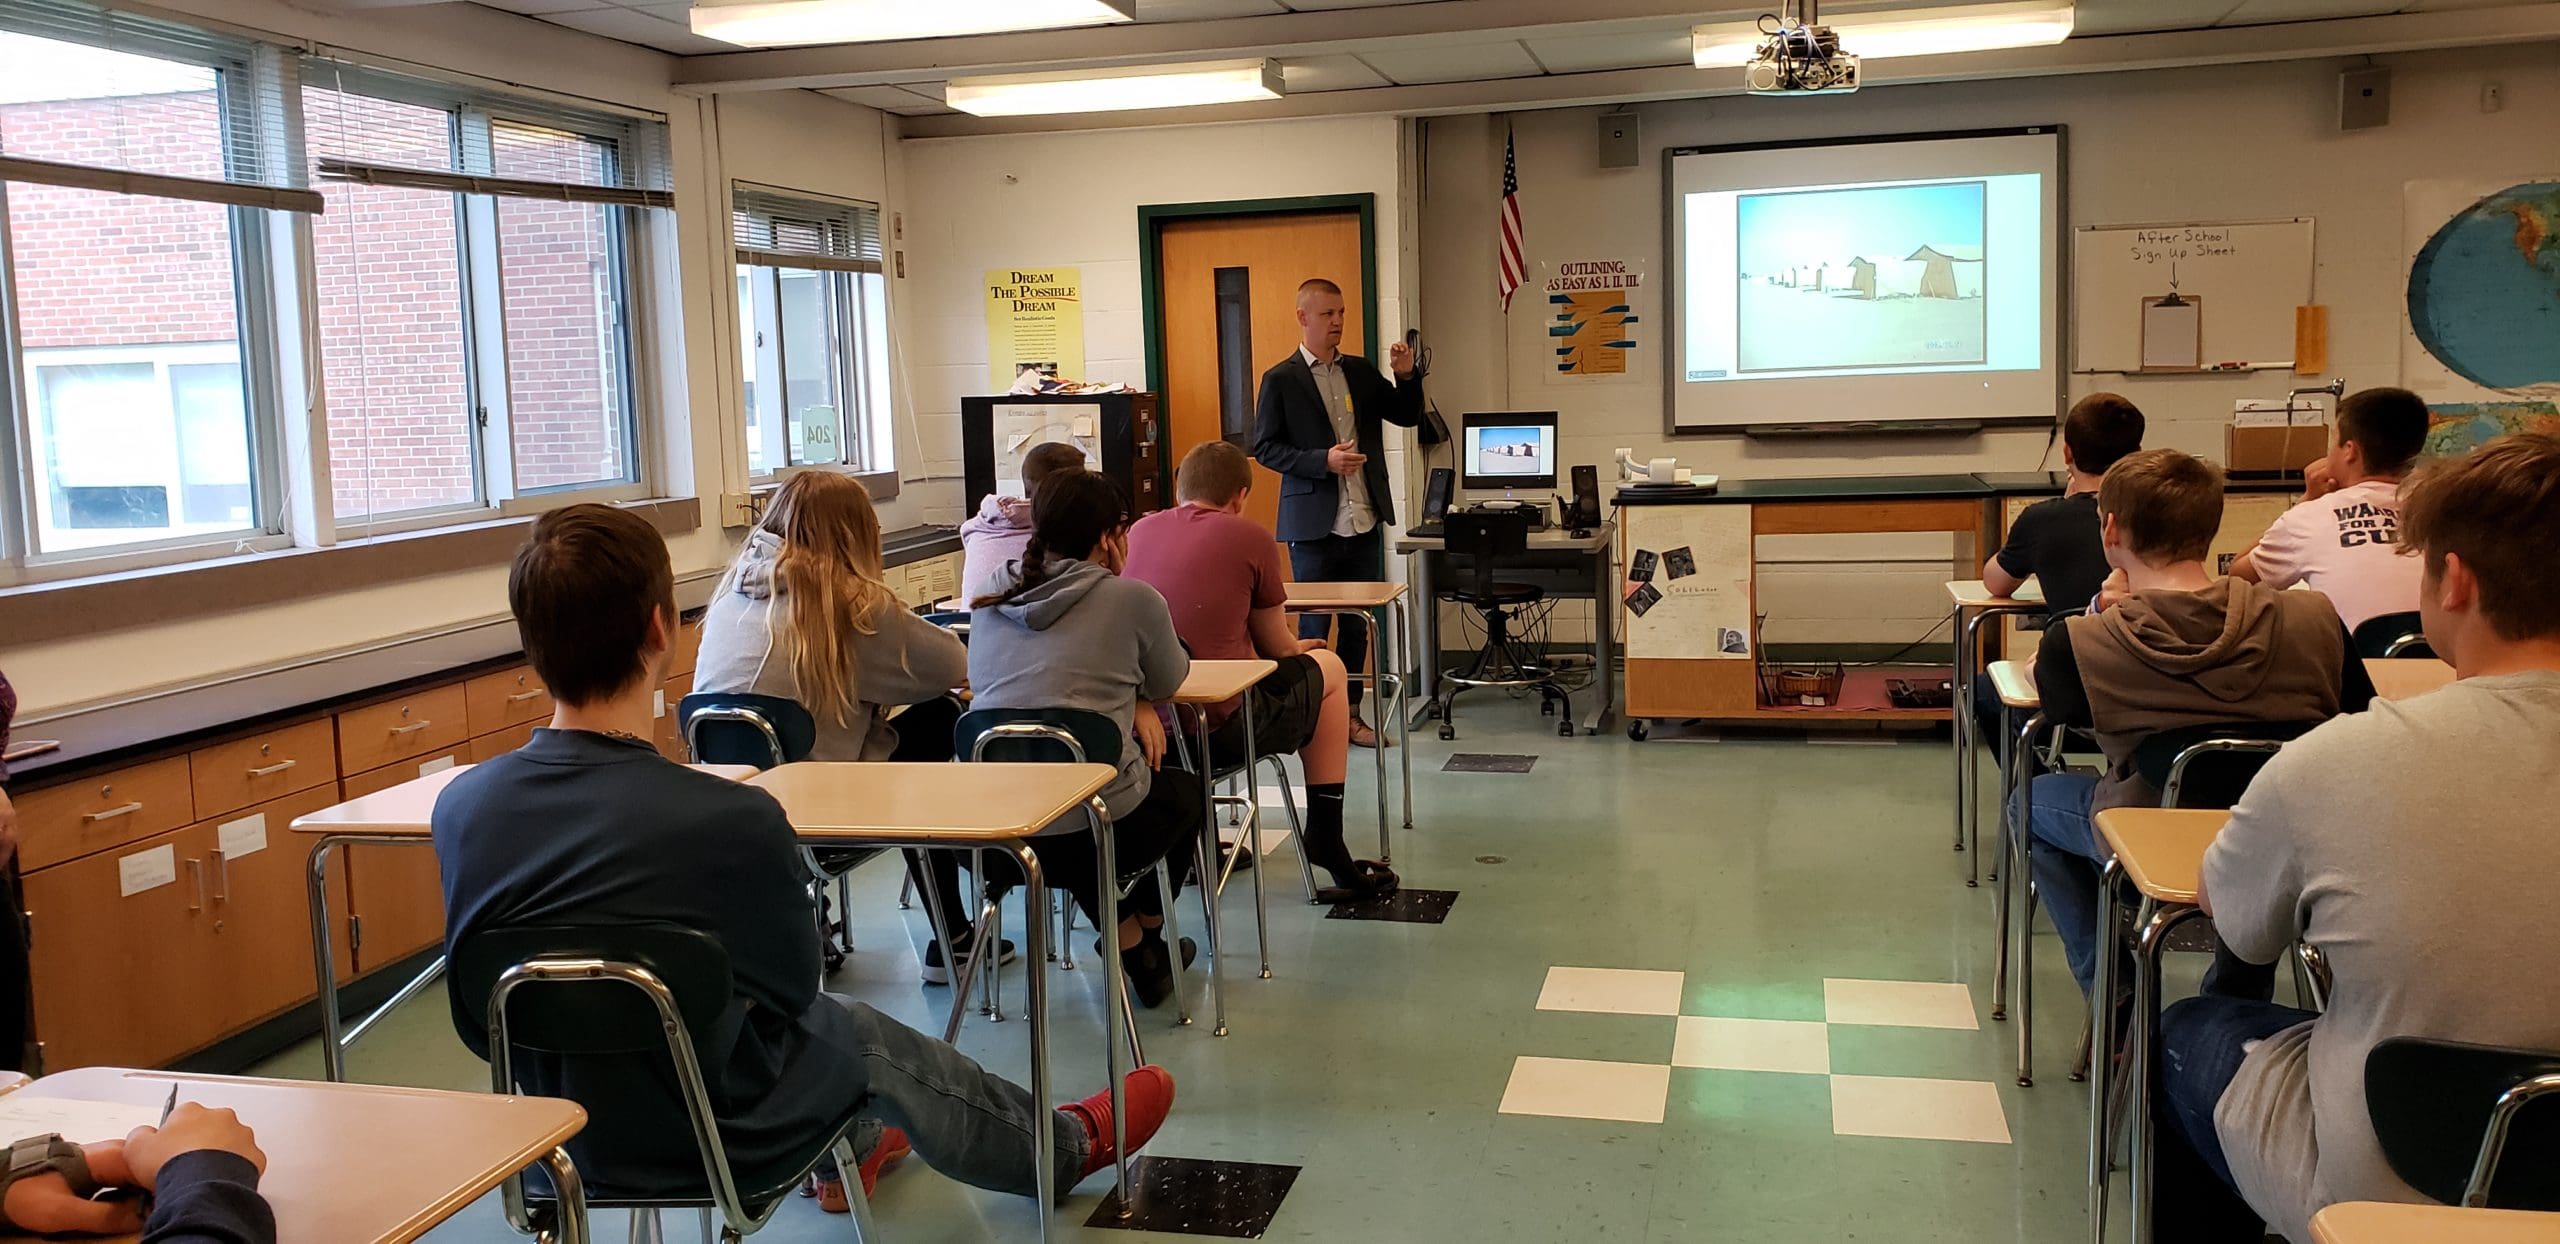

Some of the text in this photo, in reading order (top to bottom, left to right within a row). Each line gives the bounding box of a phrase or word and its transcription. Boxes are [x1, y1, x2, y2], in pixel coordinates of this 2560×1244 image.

[2138, 229, 2229, 244] After School
[2131, 247, 2161, 264] Sign
[2196, 244, 2235, 257] Sheet
[1561, 261, 1625, 276] OUTLINING:
[1547, 279, 1560, 291] AS
[1562, 277, 1588, 290] EASY
[1588, 276, 1601, 289] AS
[991, 285, 1076, 299] THE POSSIBLE
[2339, 518, 2396, 531] FOR A
[2340, 530, 2399, 548] CU
